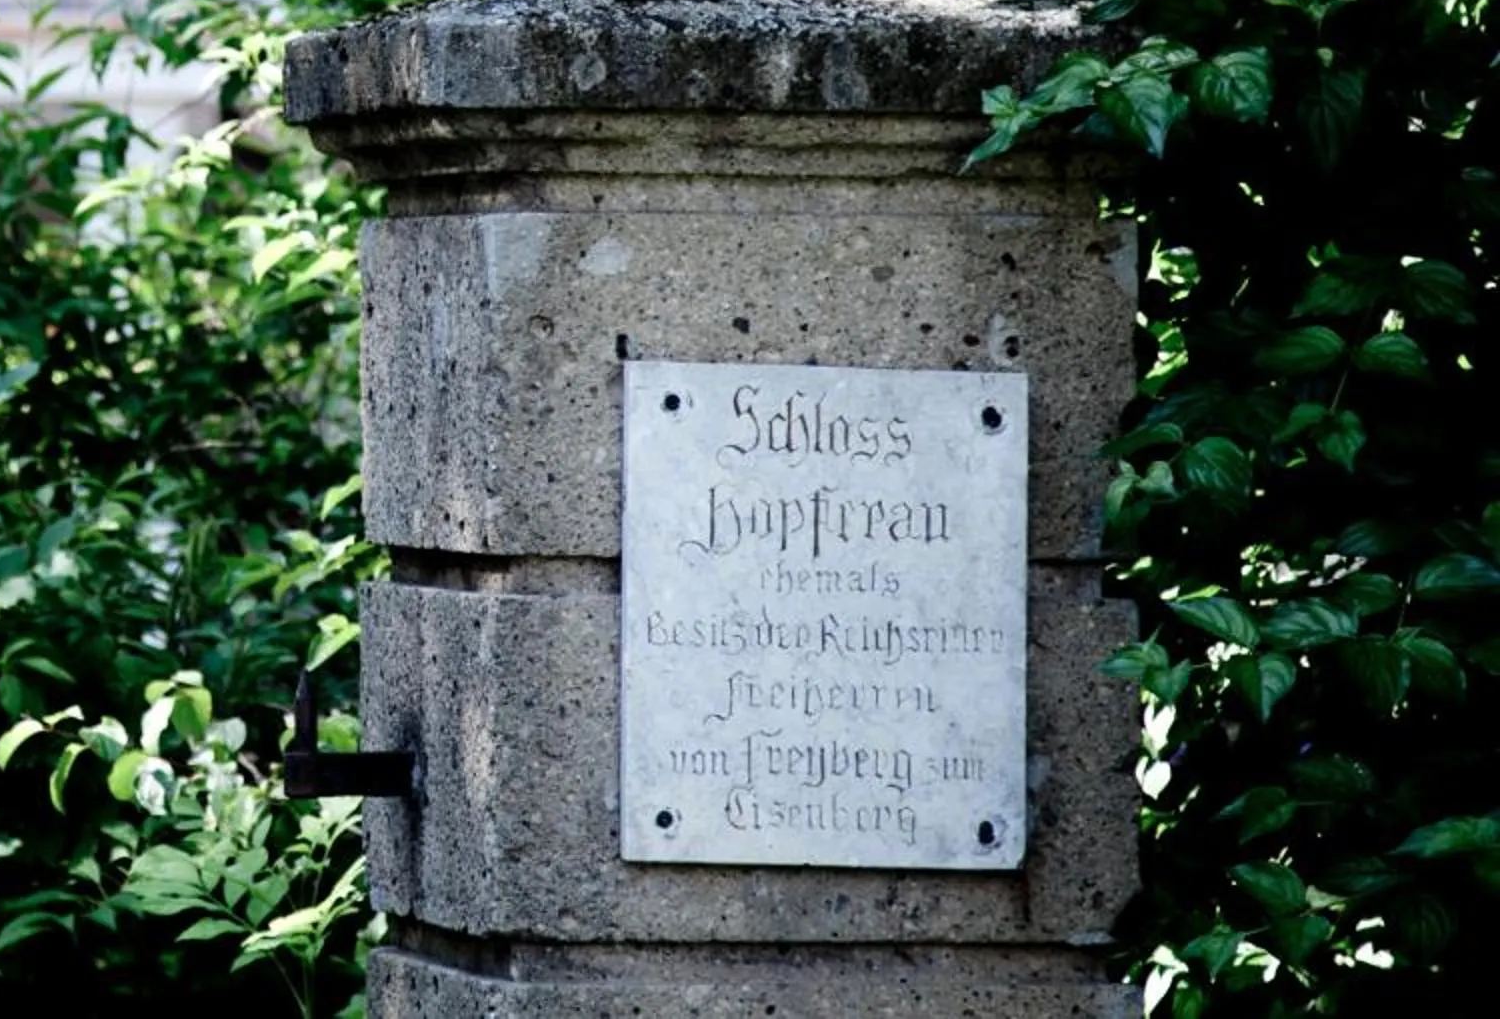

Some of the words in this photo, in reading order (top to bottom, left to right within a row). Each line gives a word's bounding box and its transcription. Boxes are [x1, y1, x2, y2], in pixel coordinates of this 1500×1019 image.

[715, 384, 912, 468] Schloss
[677, 481, 950, 558] Hopferau
[760, 559, 901, 597] ehemals
[647, 610, 748, 656] Besitz
[754, 604, 811, 650] der
[703, 670, 942, 727] Freiherren
[669, 748, 730, 778] von
[744, 727, 913, 793] Freyberg
[724, 785, 917, 847] Eisenberg
